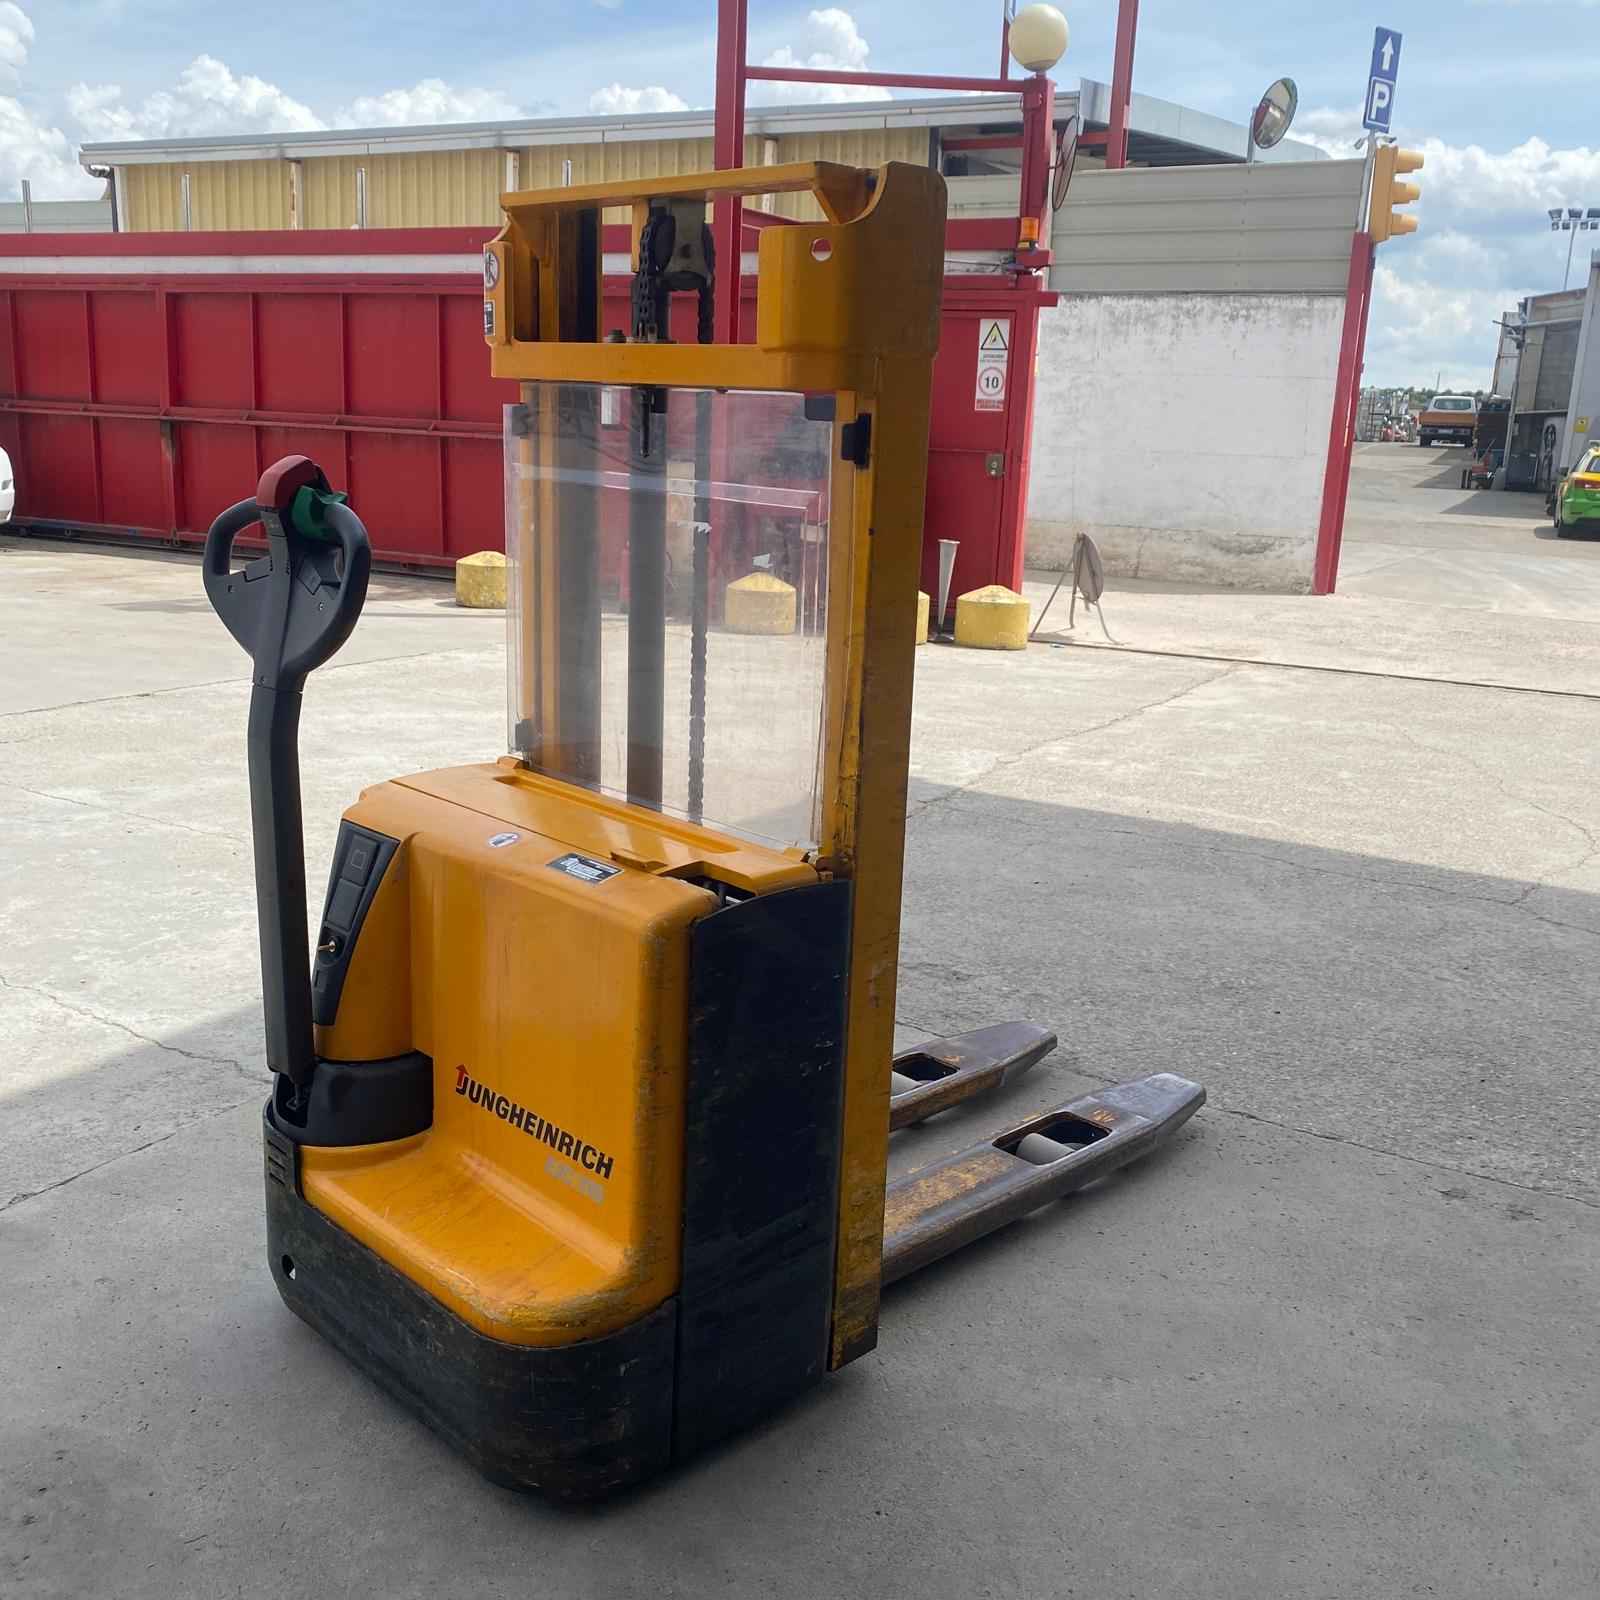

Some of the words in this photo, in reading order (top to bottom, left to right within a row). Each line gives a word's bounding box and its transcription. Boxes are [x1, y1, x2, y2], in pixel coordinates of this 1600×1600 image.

[1370, 81, 1390, 120] P
[984, 375, 999, 389] 10
[455, 1074, 614, 1180] JUNGHEINRICH
